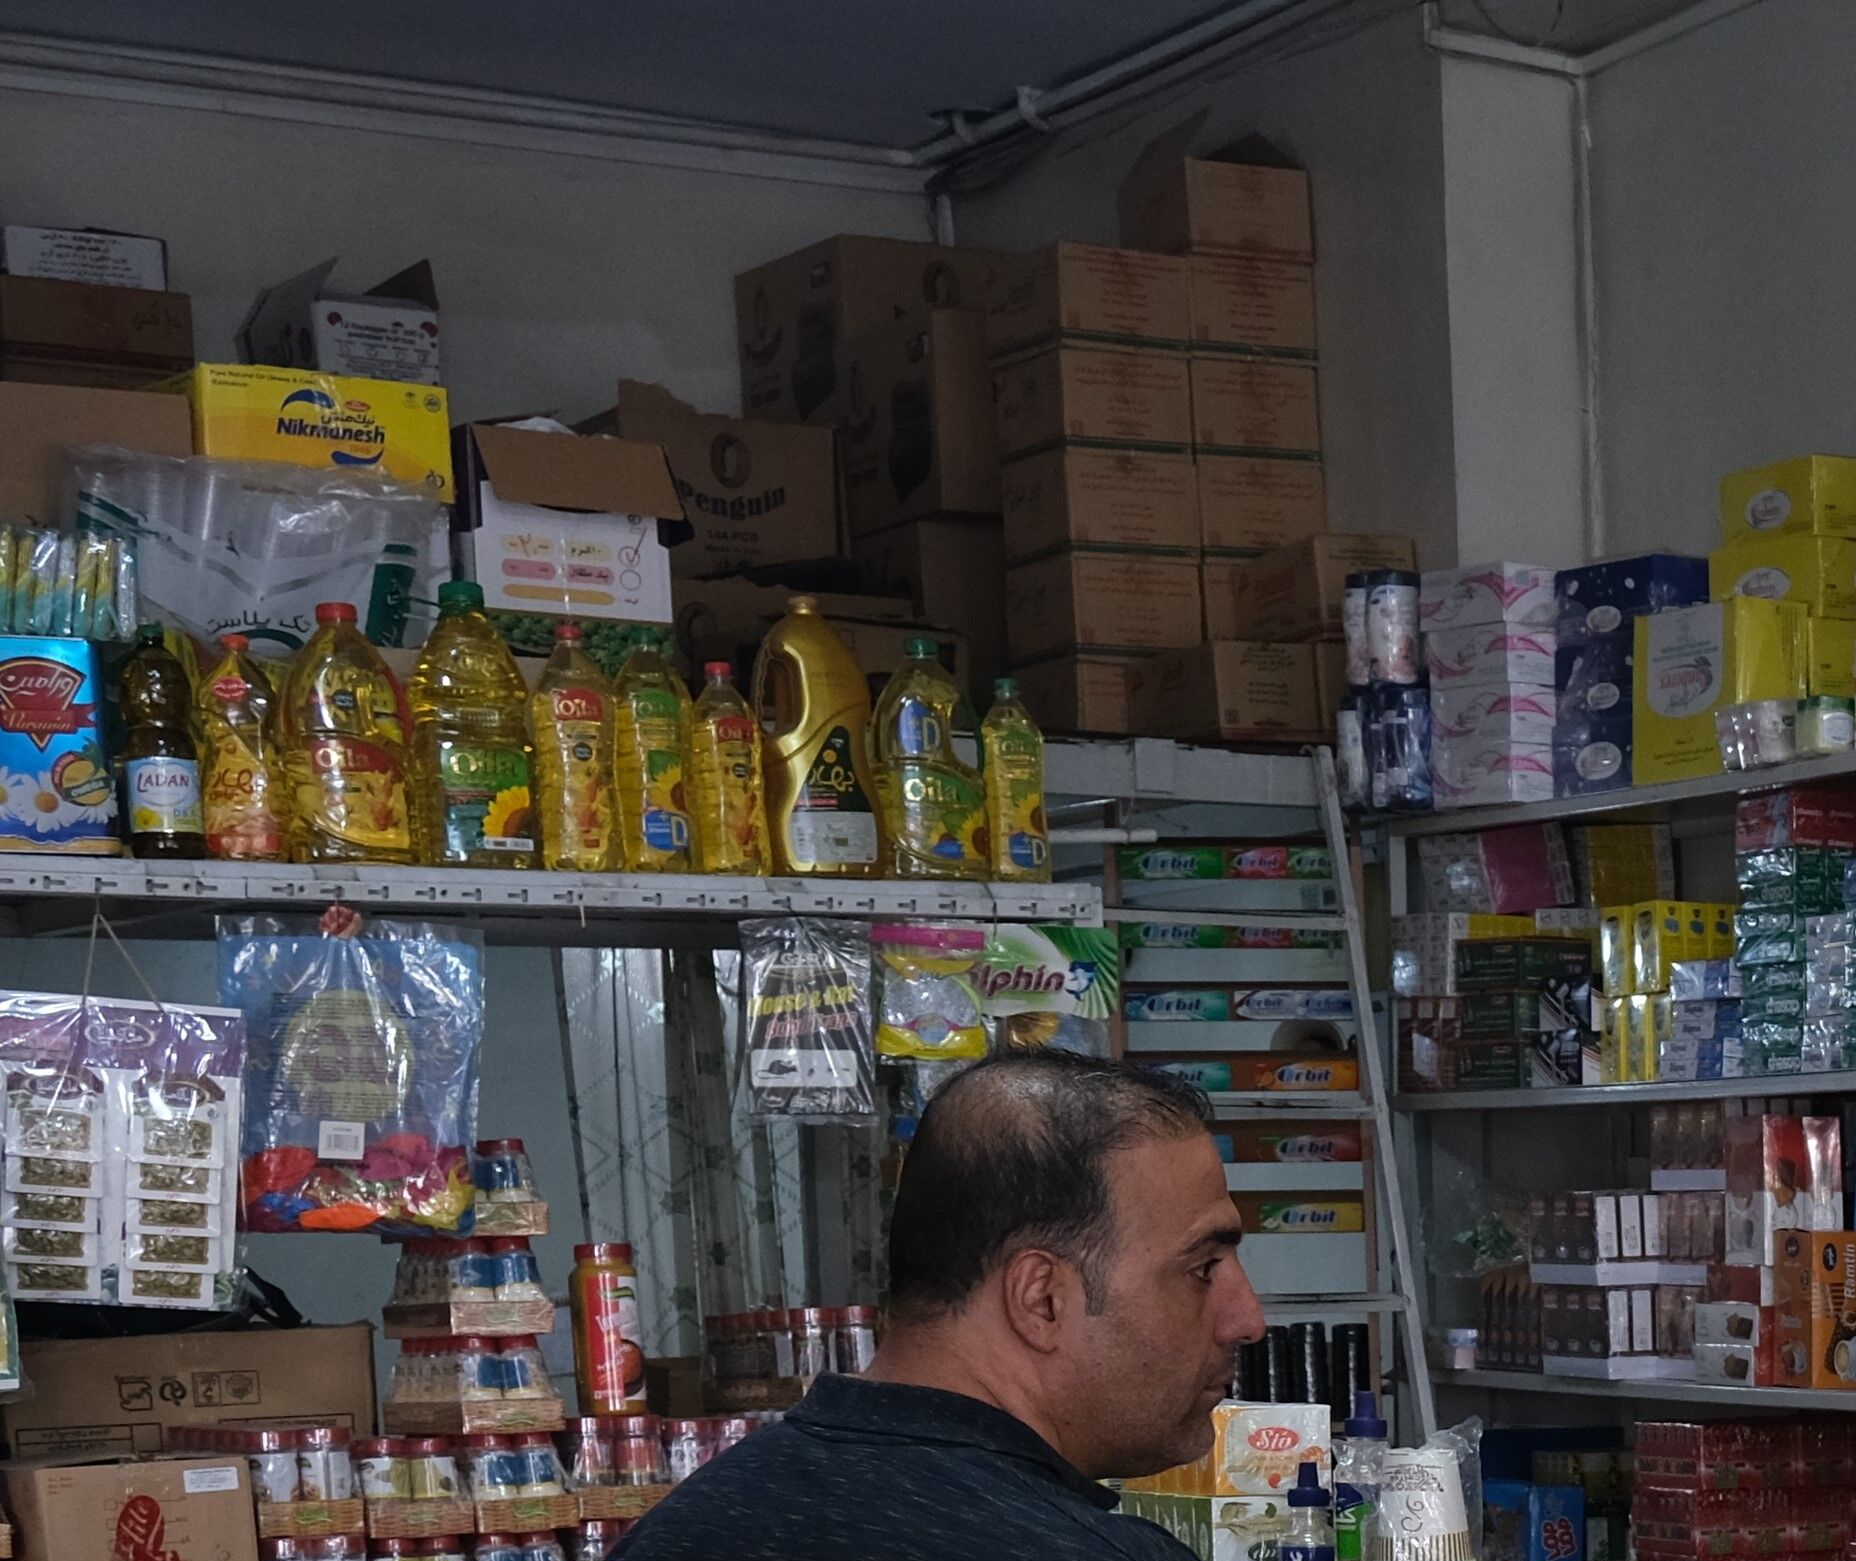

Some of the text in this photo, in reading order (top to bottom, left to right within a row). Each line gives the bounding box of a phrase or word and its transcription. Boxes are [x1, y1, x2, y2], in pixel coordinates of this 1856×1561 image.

[276, 417, 386, 446] Nikmanesh
[137, 769, 190, 793] LADAN
[1143, 926, 1199, 939] Orbit
[1148, 998, 1202, 1012] Orbit
[1278, 1068, 1331, 1083] Orbit
[1280, 1140, 1333, 1154] Orbit
[1283, 1209, 1336, 1224] Orbit
[1844, 1243, 1855, 1298] Ramtin
